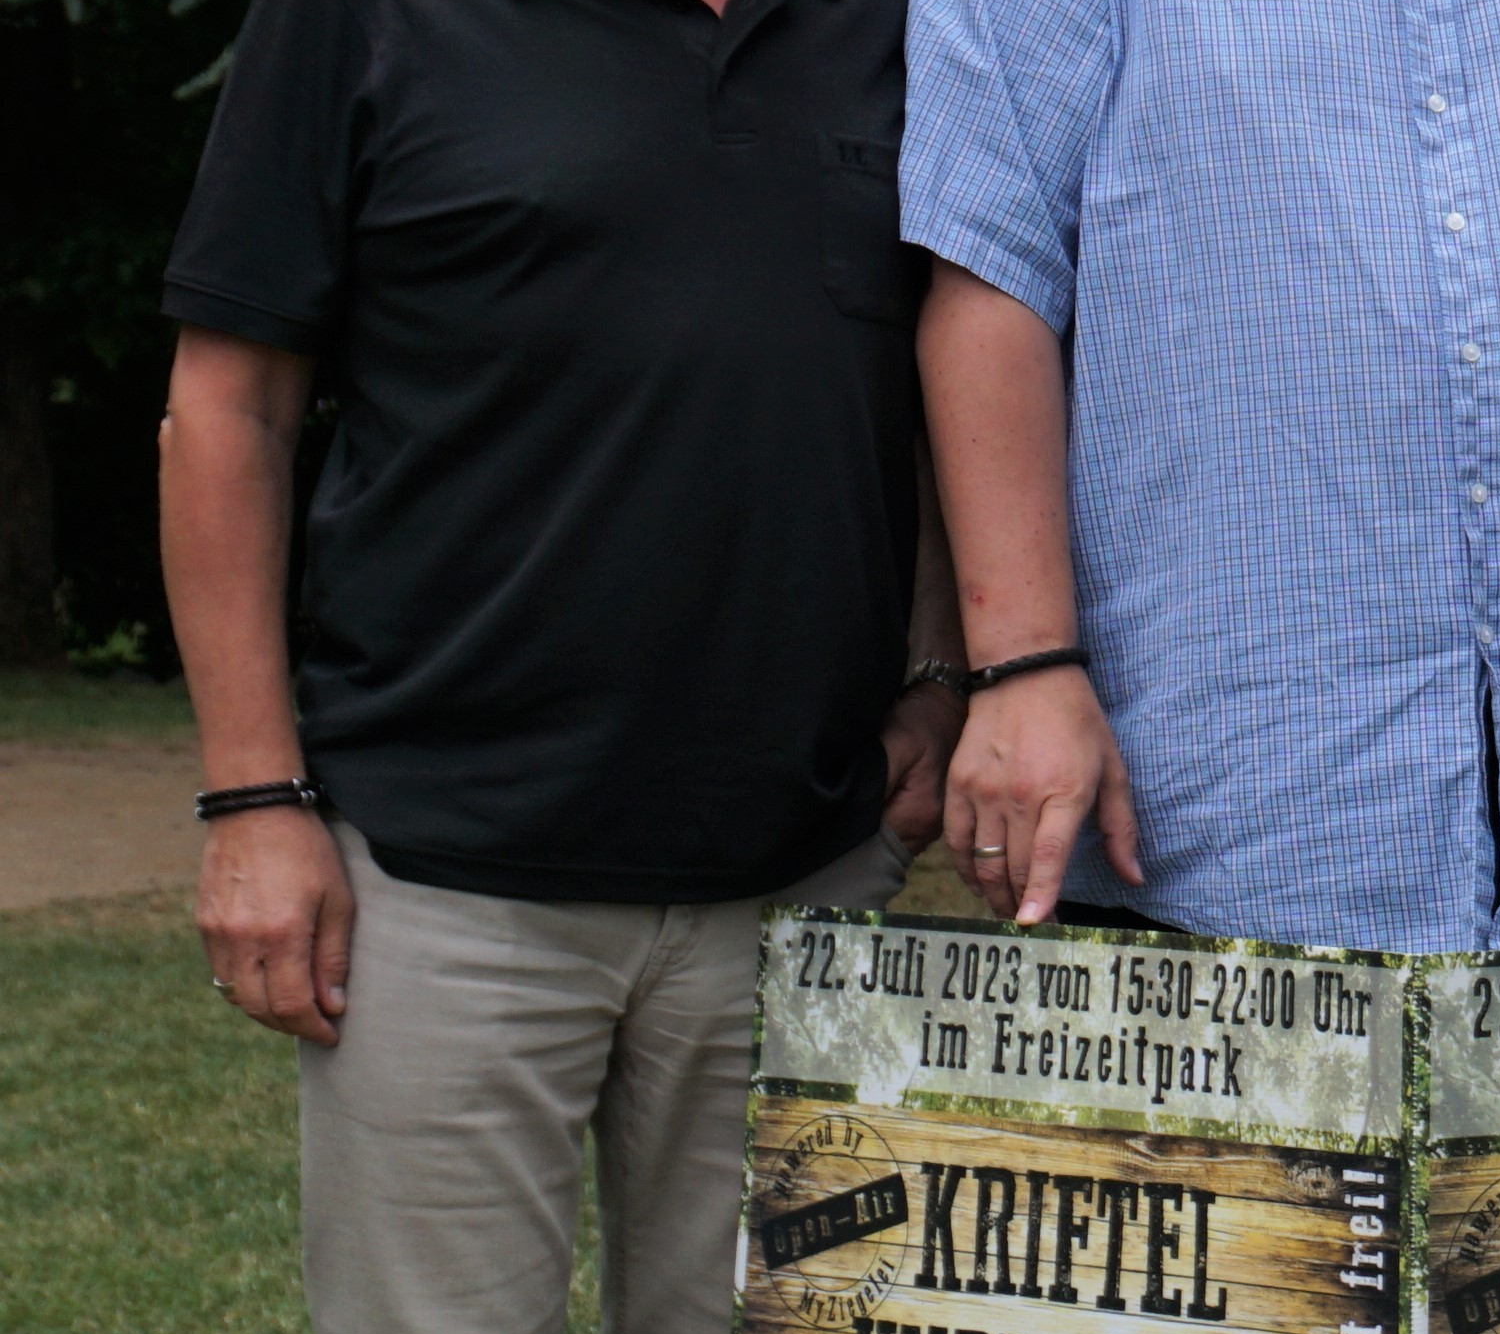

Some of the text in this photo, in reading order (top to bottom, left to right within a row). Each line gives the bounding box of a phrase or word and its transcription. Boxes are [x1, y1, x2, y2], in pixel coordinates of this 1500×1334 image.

[919, 1008, 1247, 1105] im Freizeitpark
[915, 1160, 1228, 1321] KRIFTEL
[1340, 1168, 1384, 1291] frei!
